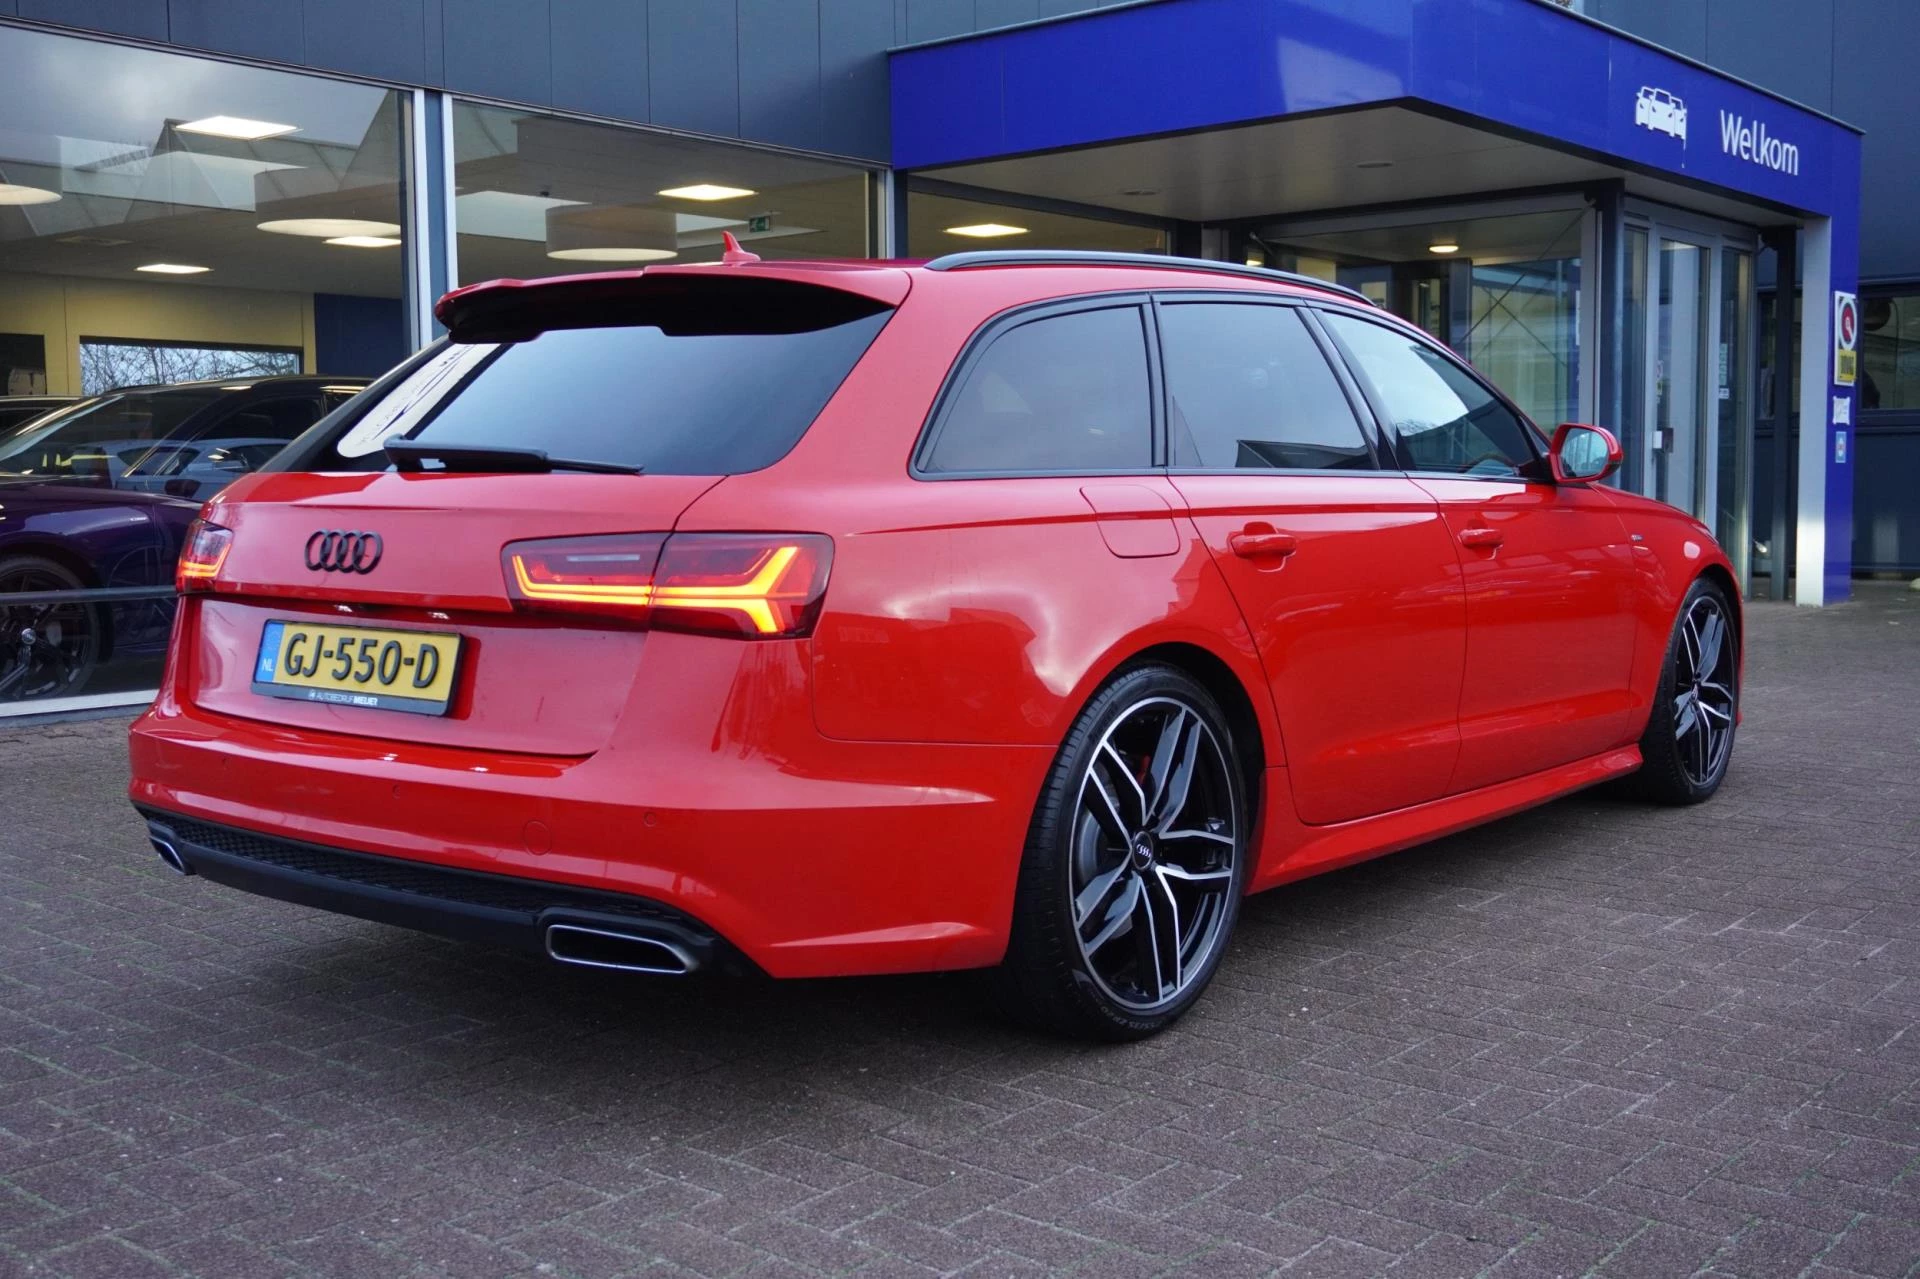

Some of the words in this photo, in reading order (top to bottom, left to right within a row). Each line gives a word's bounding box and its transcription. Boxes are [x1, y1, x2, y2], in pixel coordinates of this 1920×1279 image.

[1720, 109, 1799, 176] Welkom
[262, 657, 274, 672] NL
[284, 632, 440, 689] GJ-550-D
